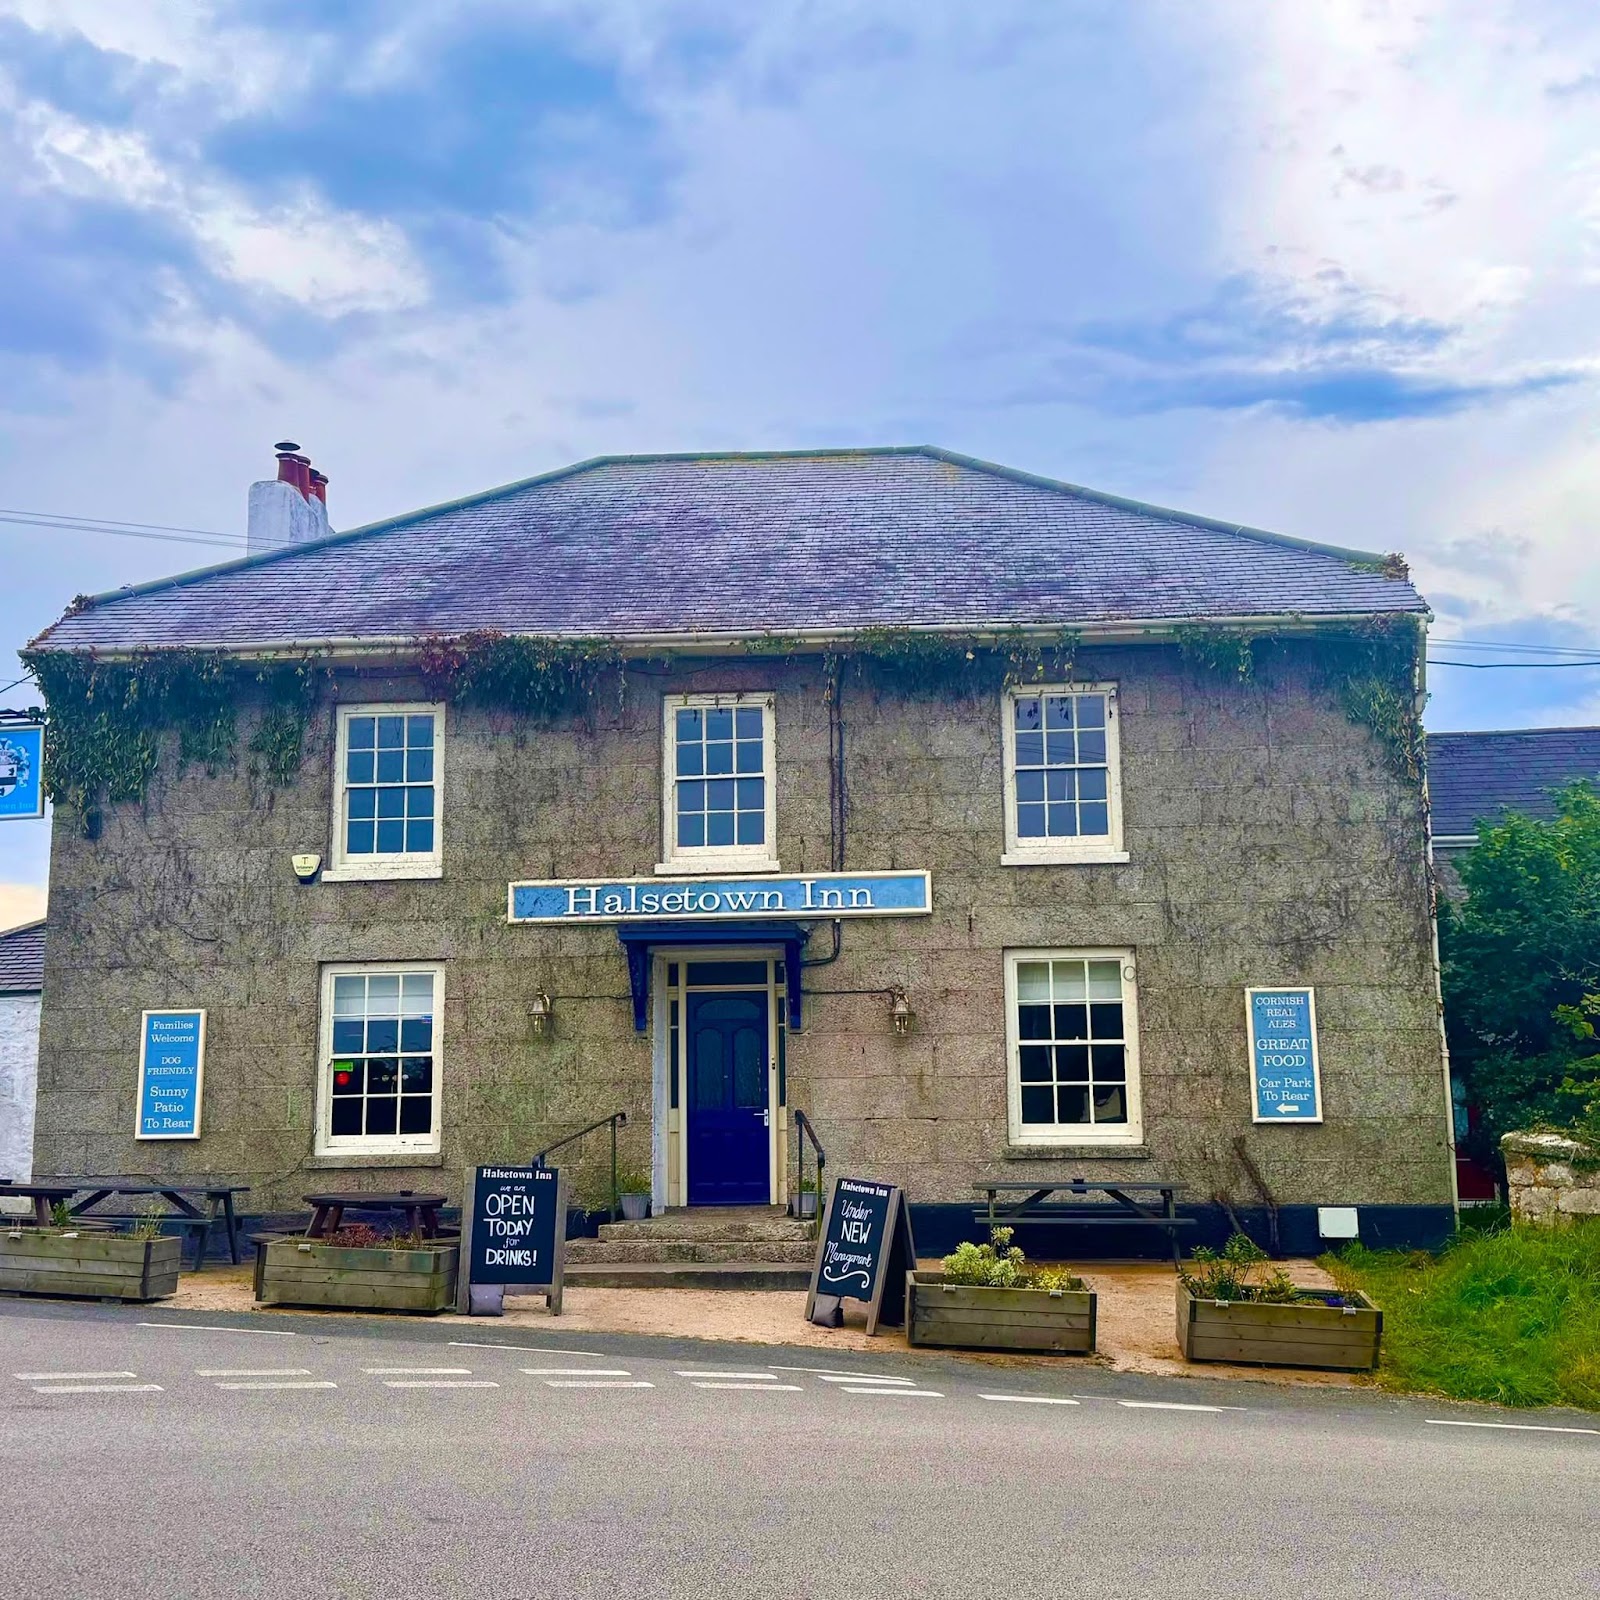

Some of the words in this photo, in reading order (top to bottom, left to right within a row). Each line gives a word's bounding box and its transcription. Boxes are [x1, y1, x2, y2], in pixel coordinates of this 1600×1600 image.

[563, 885, 786, 915] Halsetown
[800, 880, 875, 909] Inn
[1255, 996, 1305, 1006] CORNISH
[1266, 1008, 1296, 1017] REAL
[152, 1021, 194, 1030] Families
[1267, 1020, 1297, 1029] ALES
[151, 1034, 194, 1043] Welcome
[1256, 1038, 1310, 1050] GREAT
[161, 1056, 181, 1065] DOG
[1263, 1055, 1306, 1067] FOOD
[147, 1067, 194, 1076] FRIENDLY
[1259, 1078, 1281, 1088] Car
[1284, 1078, 1312, 1088] Park
[150, 1086, 189, 1099] Sunny
[1263, 1091, 1278, 1101] To
[1282, 1091, 1310, 1101] Rear
[154, 1102, 184, 1113] Patio
[144, 1118, 160, 1129] To
[163, 1118, 192, 1129] Rear
[482, 1168, 533, 1180] Halsetown
[535, 1170, 552, 1180] Inn
[840, 1180, 875, 1195] Halsetown
[875, 1186, 888, 1197] Inn
[486, 1193, 535, 1216] OPEN
[841, 1199, 873, 1221] Under
[483, 1218, 534, 1237] TODAY
[840, 1220, 872, 1244] NEW
[503, 1237, 520, 1249] for
[485, 1248, 538, 1267] DRINKS!
